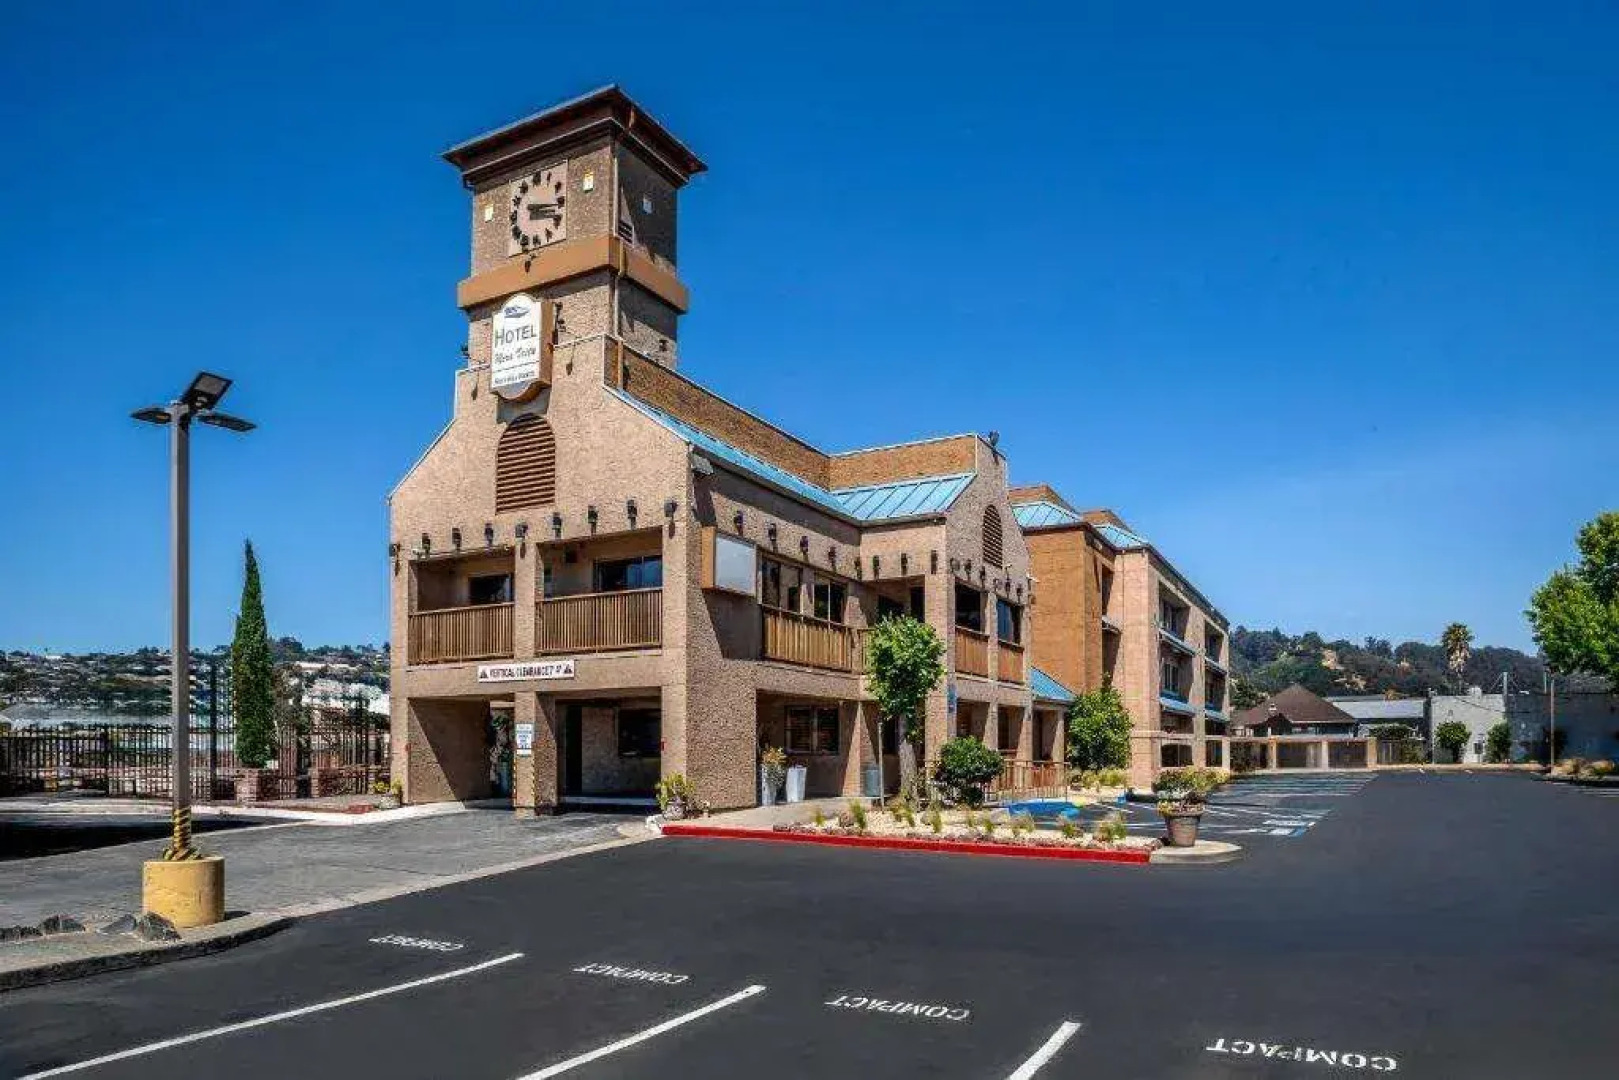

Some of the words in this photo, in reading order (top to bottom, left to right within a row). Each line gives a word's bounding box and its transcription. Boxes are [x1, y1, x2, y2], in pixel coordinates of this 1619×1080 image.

[494, 324, 537, 348] HOTEL
[824, 995, 970, 1022] COMPACT
[1206, 1037, 1397, 1072] COMPACT
